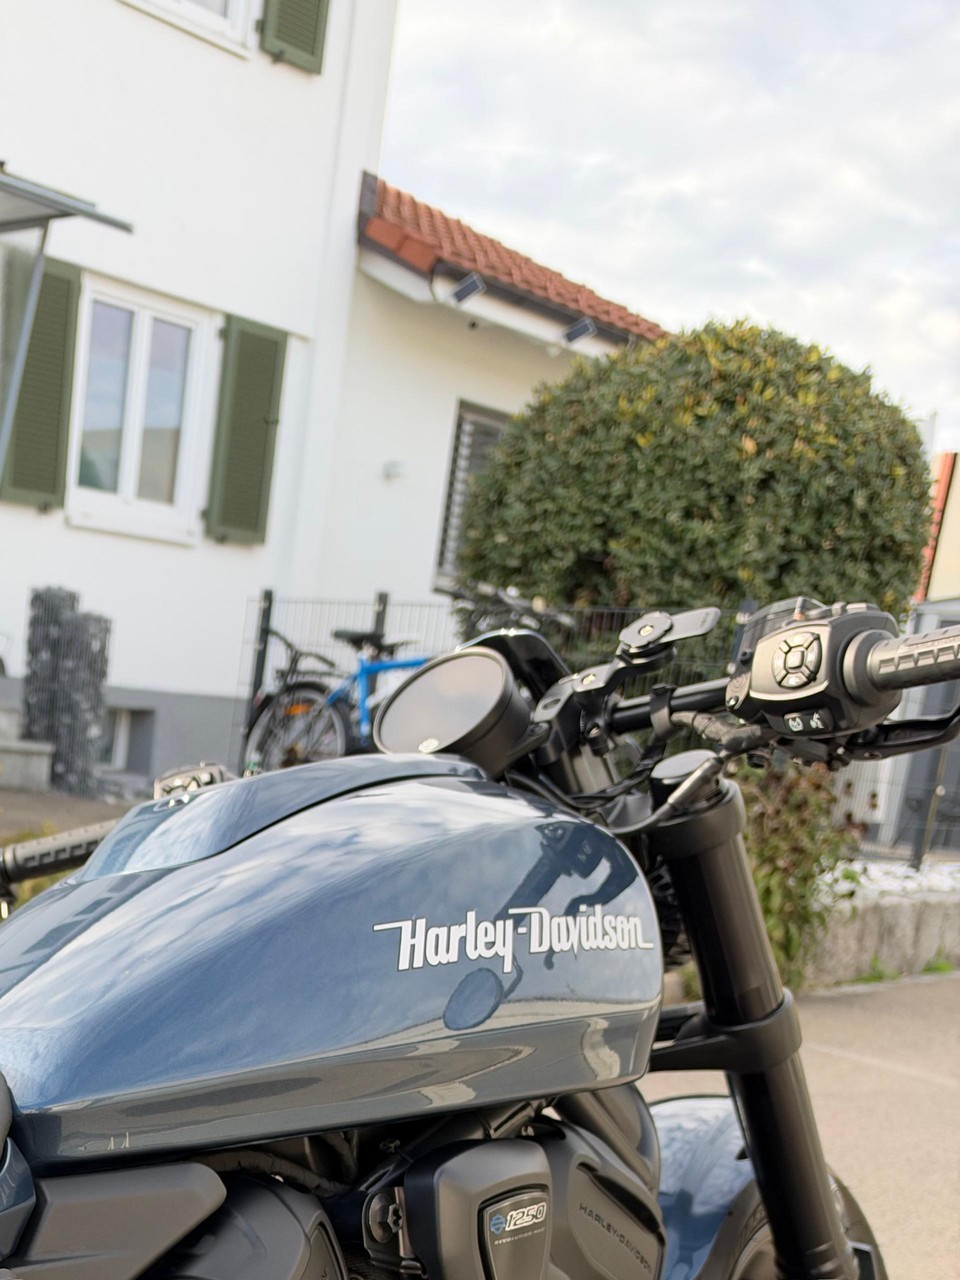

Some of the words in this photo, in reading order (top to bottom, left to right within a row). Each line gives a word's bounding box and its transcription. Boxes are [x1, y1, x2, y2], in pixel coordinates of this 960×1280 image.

[373, 904, 654, 973] Harley-Davidson
[505, 1202, 547, 1231] 1250
[579, 1203, 653, 1274] HARLEY-DAVIDSON
